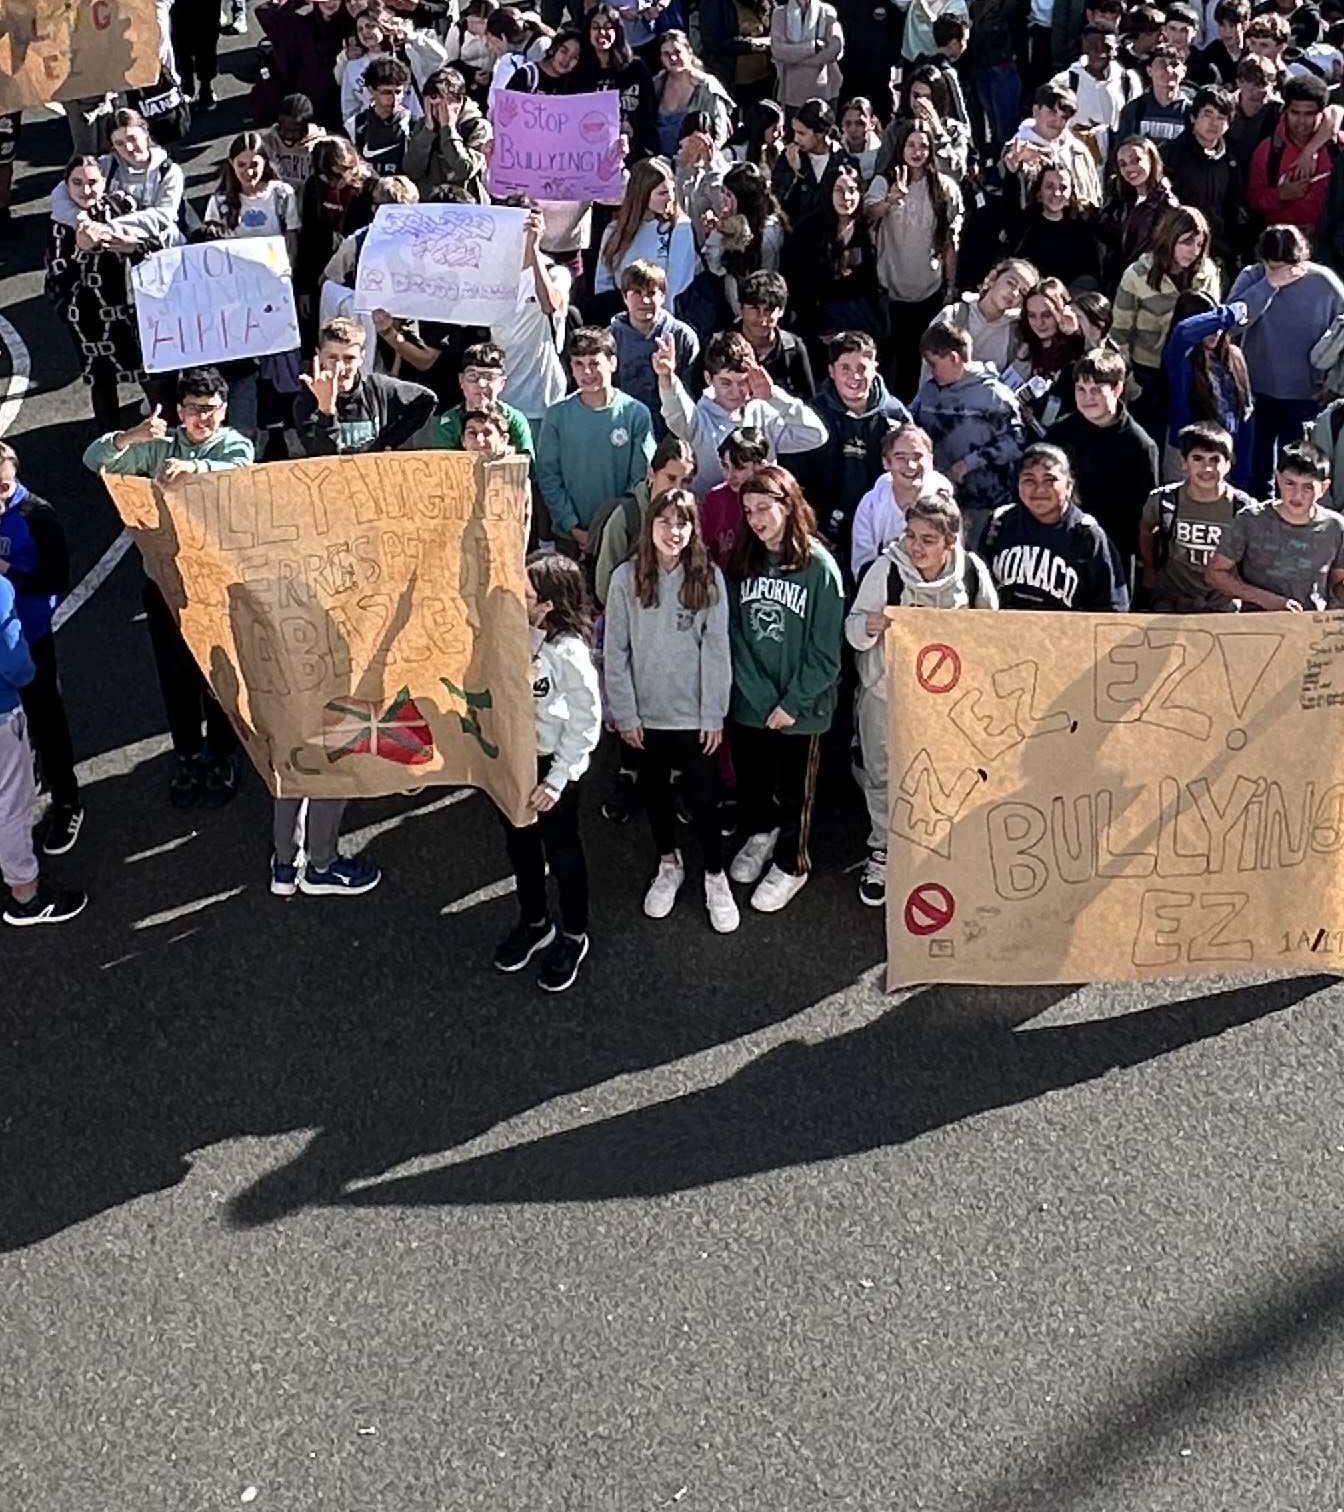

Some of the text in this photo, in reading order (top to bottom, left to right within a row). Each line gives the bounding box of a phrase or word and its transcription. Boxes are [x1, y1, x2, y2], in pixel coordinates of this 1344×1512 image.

[993, 544, 1080, 609] MONACO
[1190, 549, 1216, 566] LI
[740, 576, 808, 619] ALIFORNIA
[1131, 888, 1255, 968] EZ
